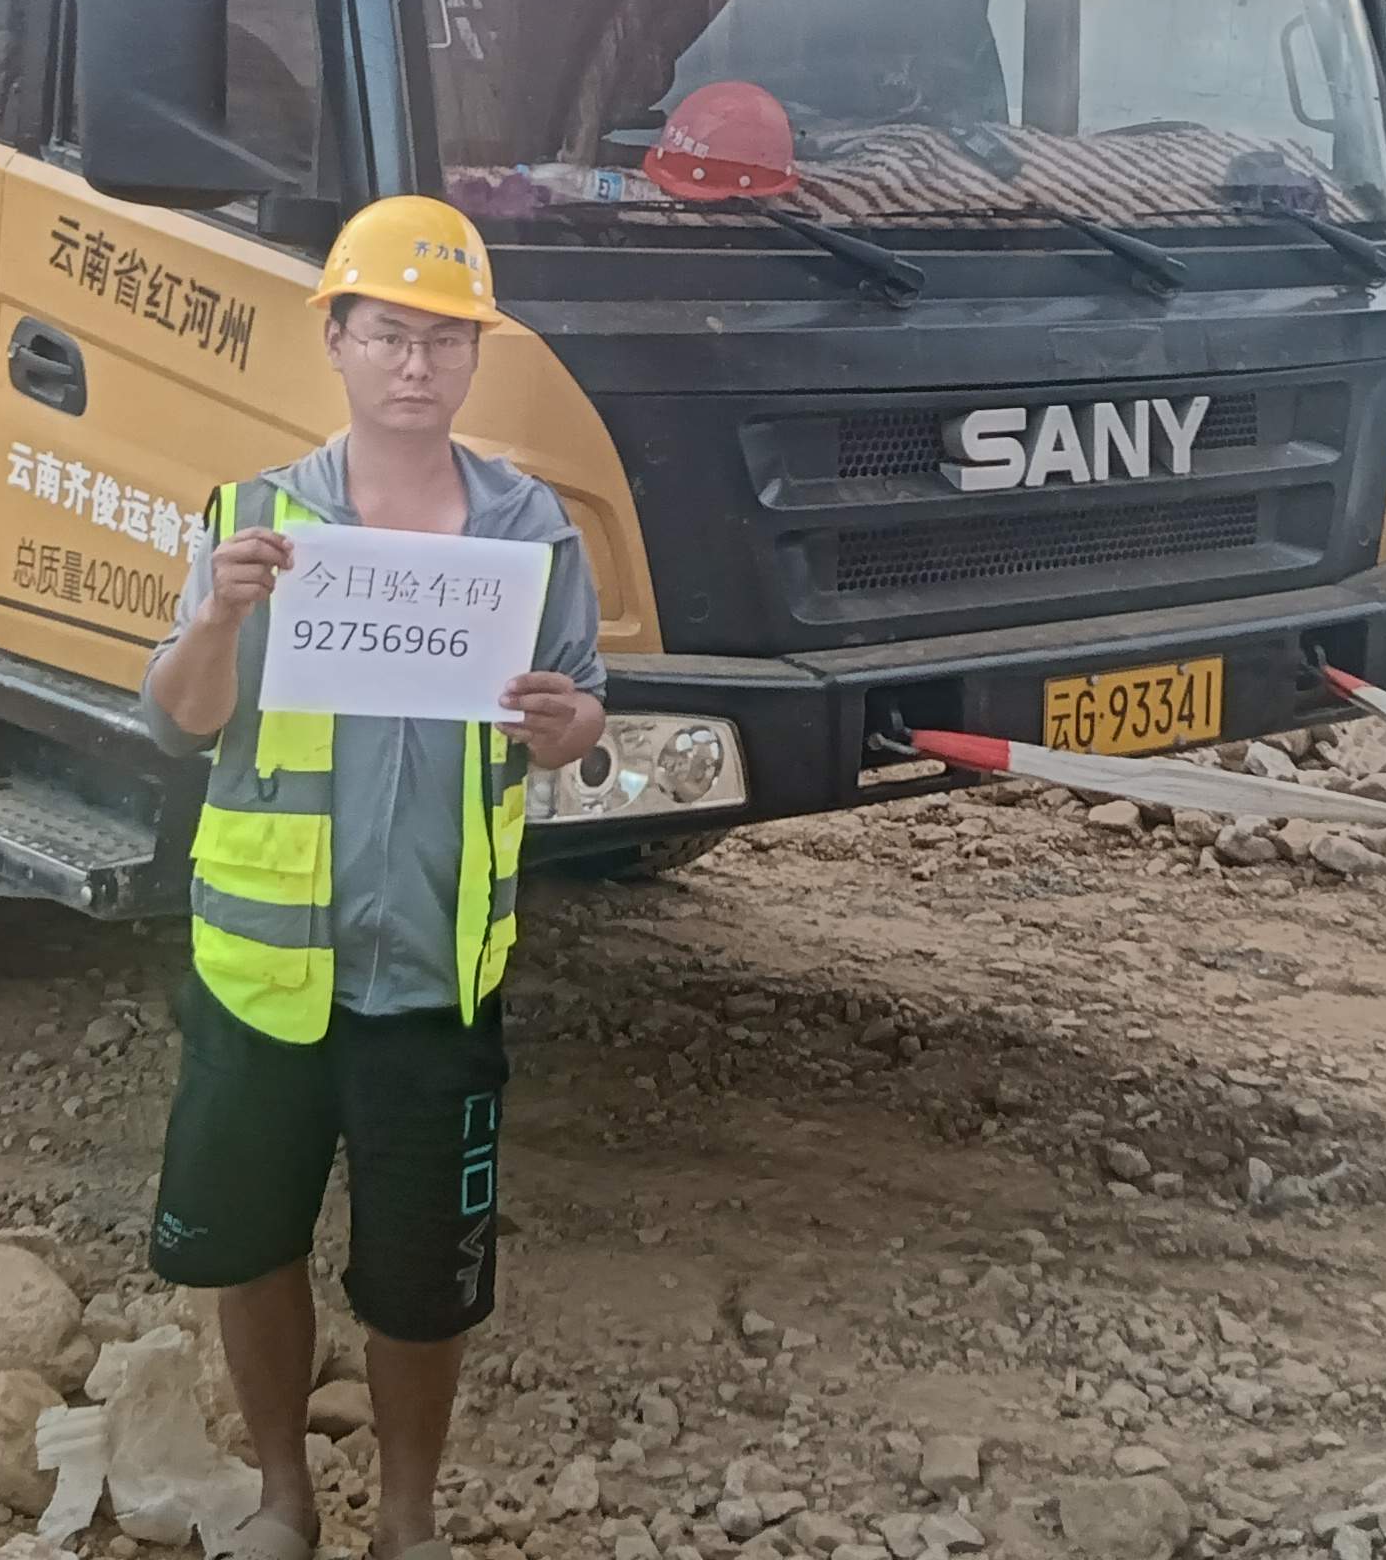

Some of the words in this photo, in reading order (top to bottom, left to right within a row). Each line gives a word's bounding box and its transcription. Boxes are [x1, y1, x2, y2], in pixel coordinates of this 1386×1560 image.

[49, 215, 256, 372] 云南省红河州
[961, 396, 1211, 491] SANY
[300, 560, 502, 612] 今日验车码
[293, 619, 470, 658] 92756966
